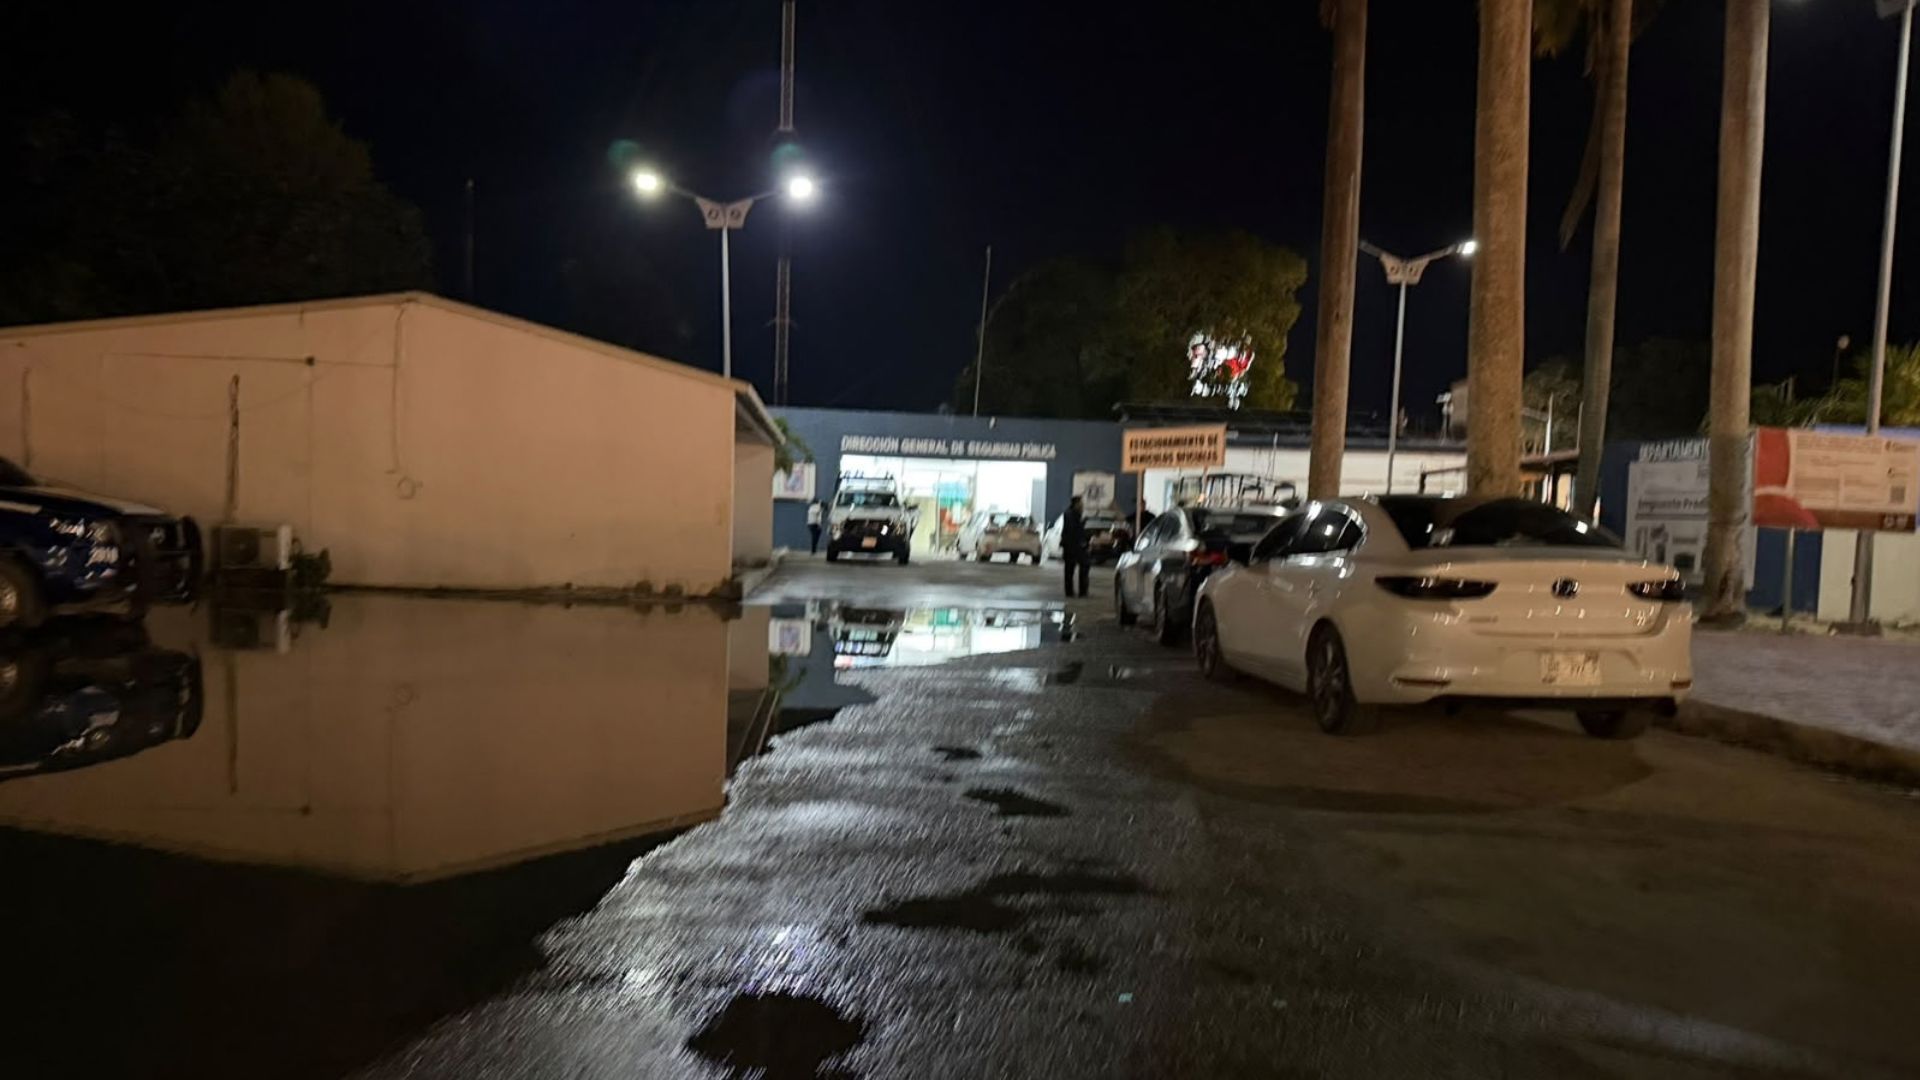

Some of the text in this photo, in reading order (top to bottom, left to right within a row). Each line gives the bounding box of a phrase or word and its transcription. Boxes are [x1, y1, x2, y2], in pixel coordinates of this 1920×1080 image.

[841, 434, 900, 454] DIRECCIÓN
[901, 438, 949, 456] GENERAL
[951, 440, 965, 456] DE
